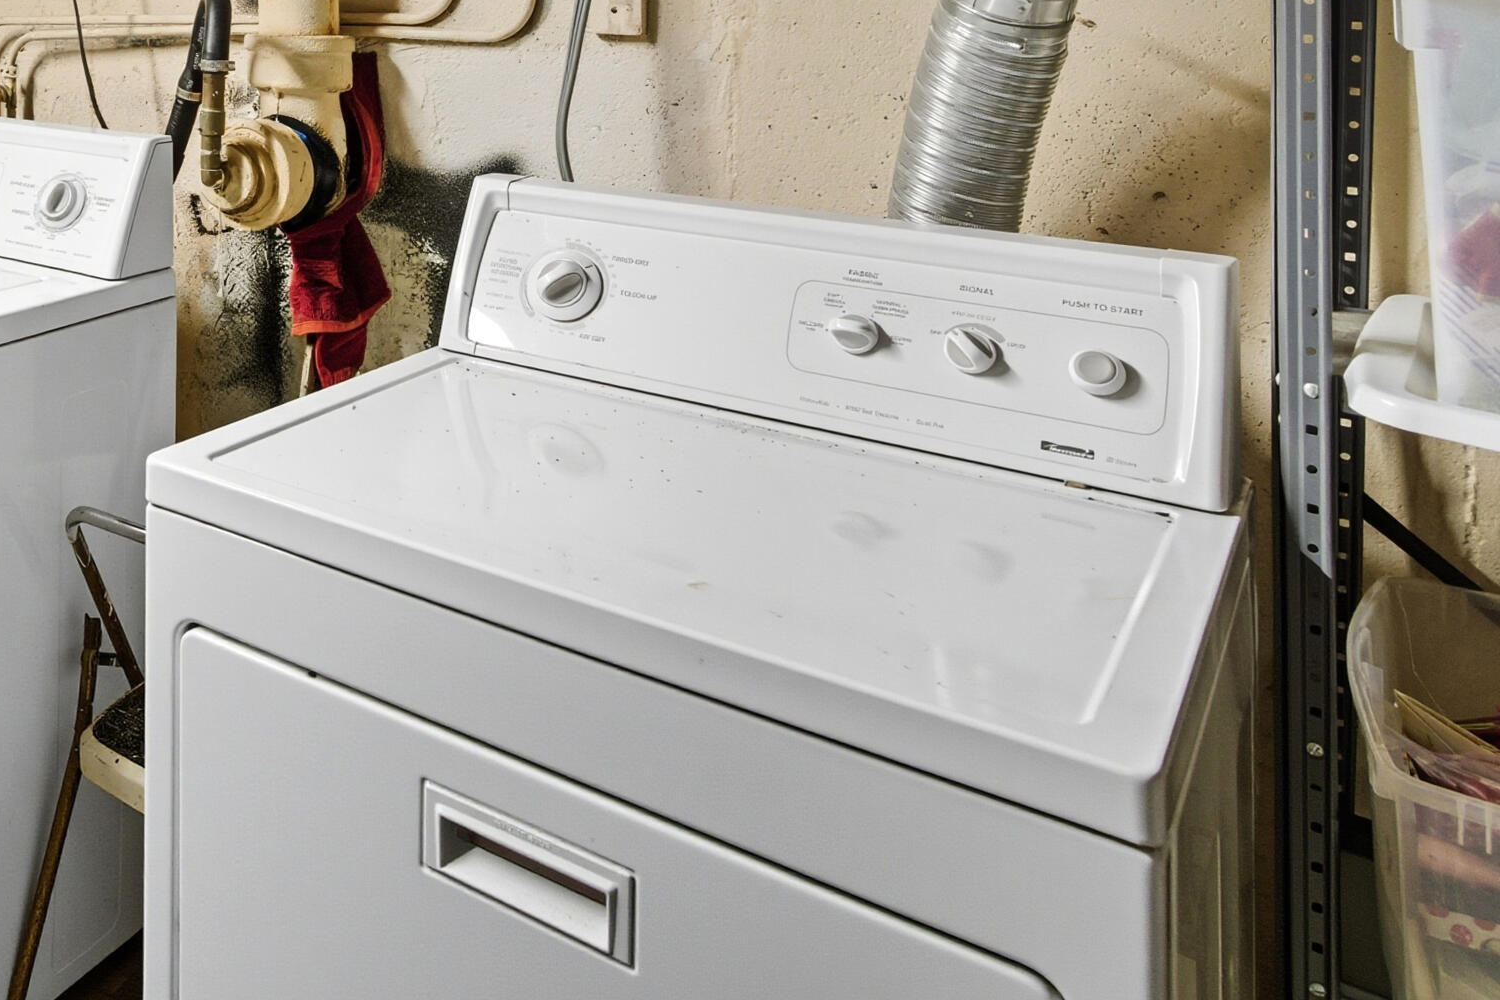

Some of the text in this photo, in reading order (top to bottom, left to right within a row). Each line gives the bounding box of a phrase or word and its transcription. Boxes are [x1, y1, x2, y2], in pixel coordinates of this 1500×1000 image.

[1062, 298, 1144, 317] PUSH TO START
